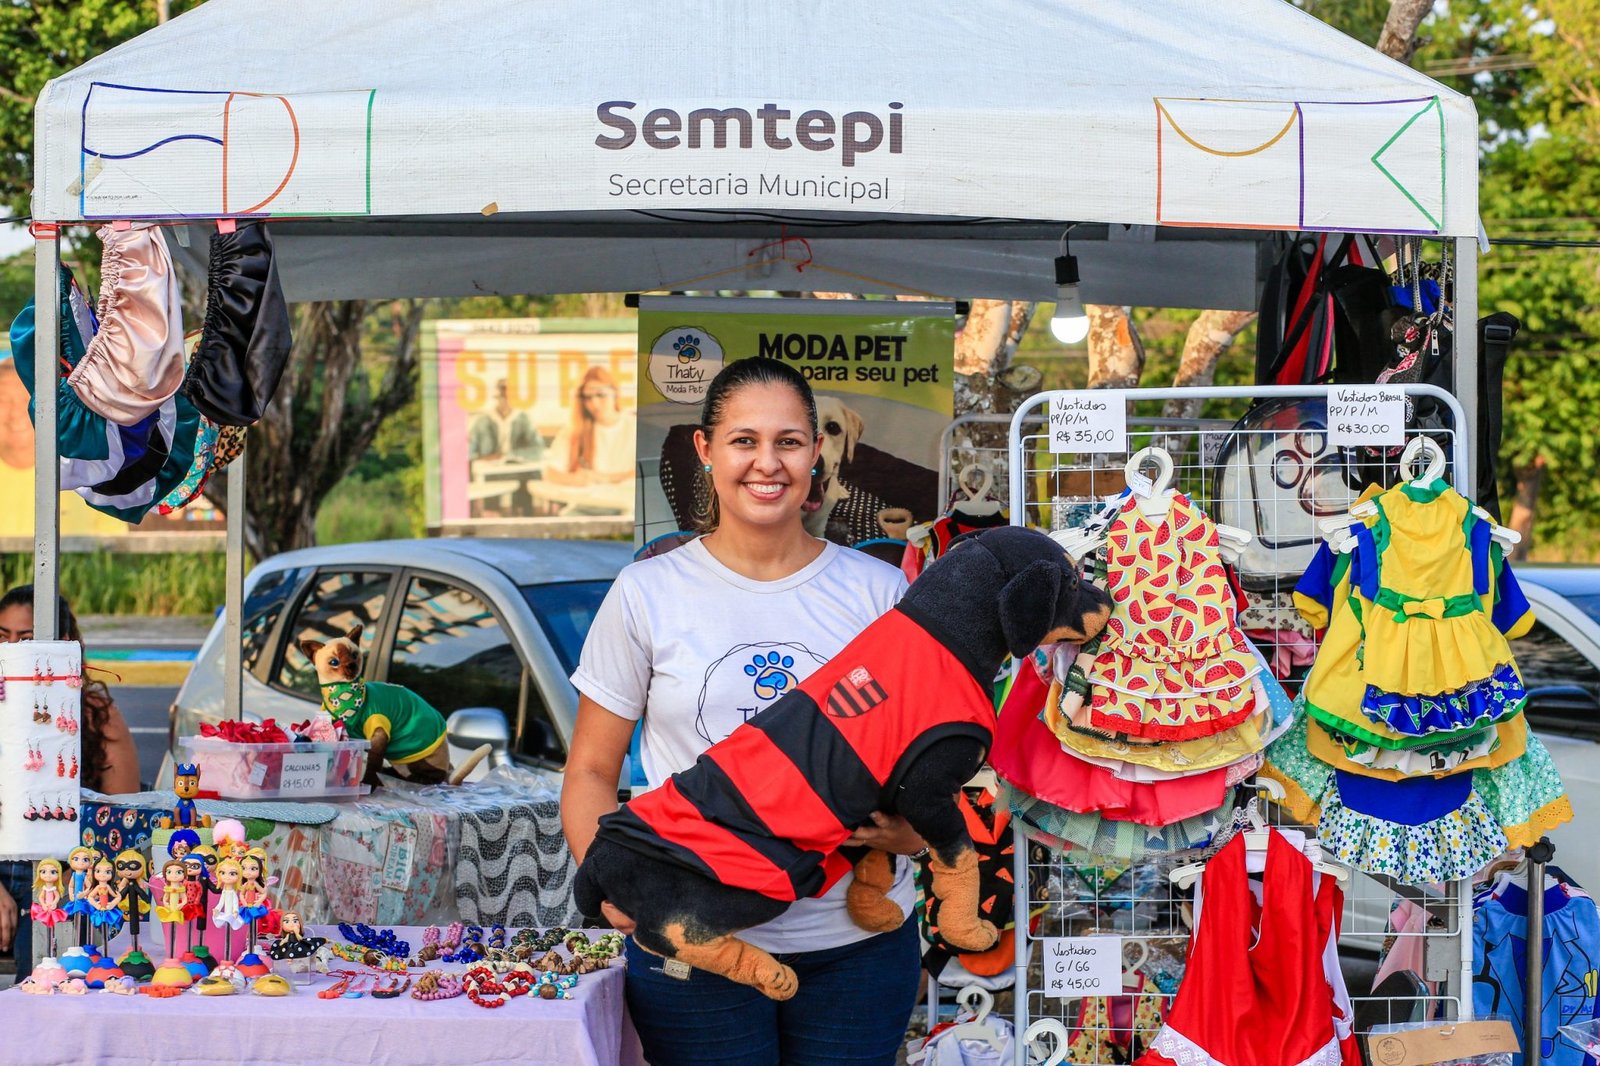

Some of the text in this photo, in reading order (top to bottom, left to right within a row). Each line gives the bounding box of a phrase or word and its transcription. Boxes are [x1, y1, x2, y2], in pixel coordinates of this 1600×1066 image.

[594, 100, 904, 167] Semtepi
[608, 173, 889, 204] Secretaria Municipal
[758, 333, 908, 362] MODA PET
[666, 365, 705, 382] Thaty
[800, 364, 939, 387] para seu pet
[666, 385, 704, 394] Moda Pet
[1337, 389, 1378, 403] Vestidos
[1056, 397, 1107, 411] Vestidos
[1074, 429, 1114, 444] 35,00
[1052, 942, 1097, 957] Vestidos
[1067, 977, 1100, 990] 45,00
